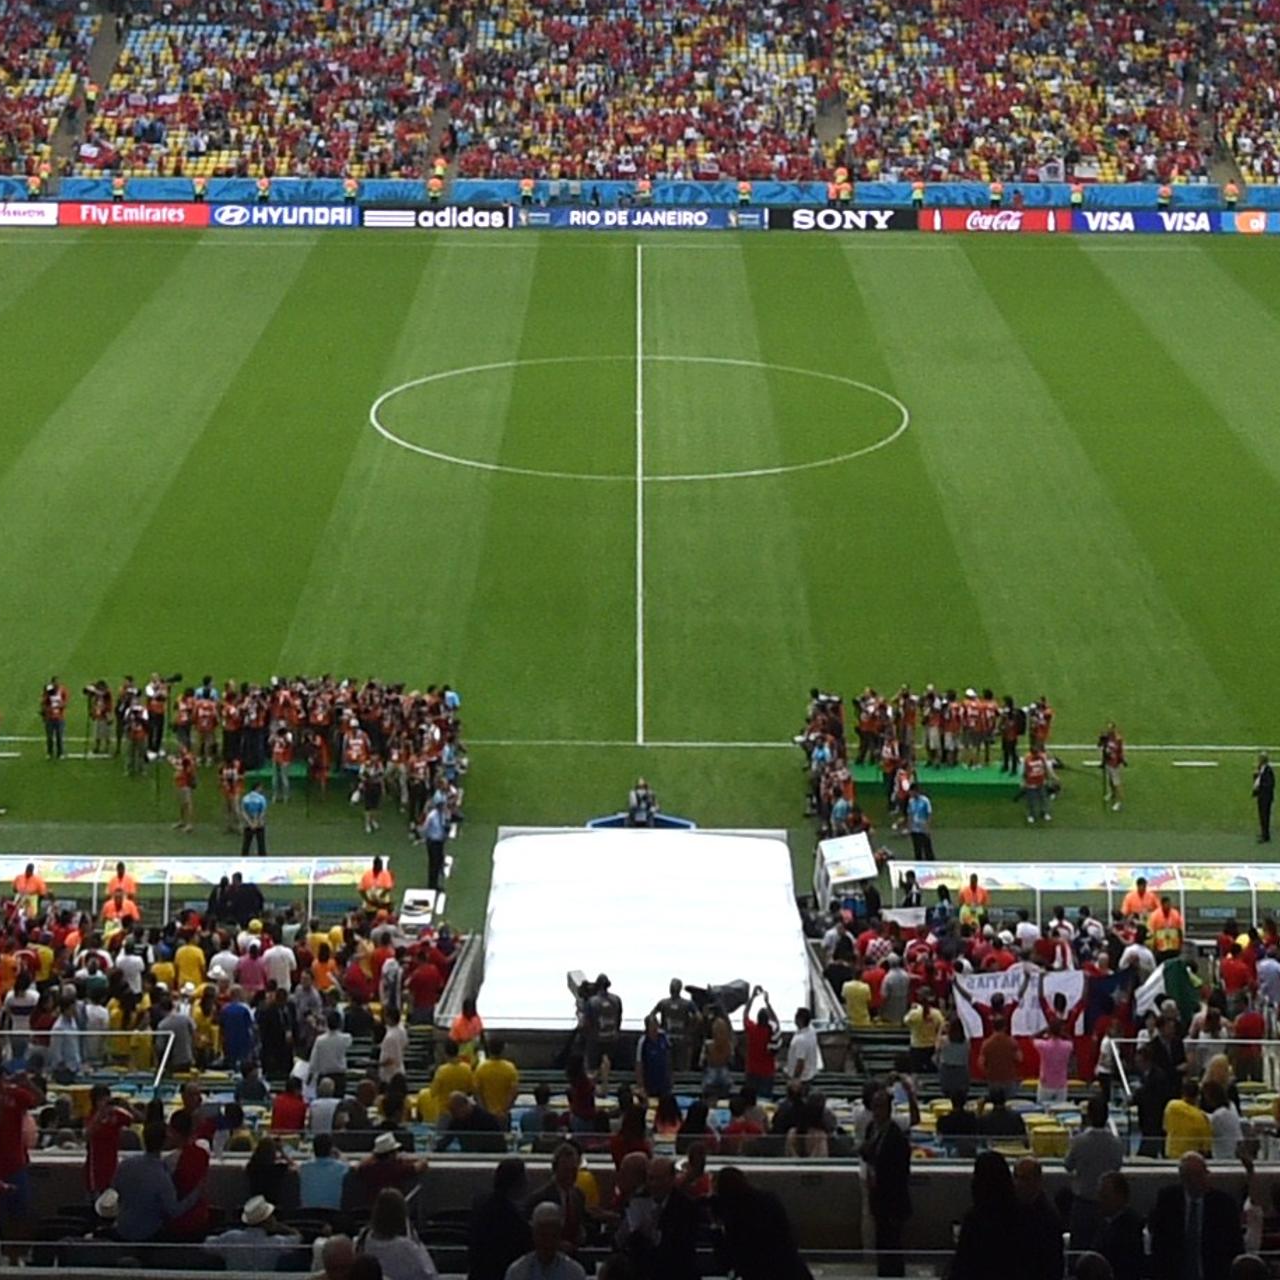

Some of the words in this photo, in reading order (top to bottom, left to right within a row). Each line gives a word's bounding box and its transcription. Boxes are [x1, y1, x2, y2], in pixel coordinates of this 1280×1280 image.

[79, 204, 108, 225] Fly
[111, 204, 185, 223] Emirates
[253, 207, 351, 225] HYUNDAI
[418, 206, 505, 228] adidas
[570, 210, 600, 226] RIO
[604, 210, 628, 226] DE
[632, 210, 708, 227] JANEIRO
[792, 209, 894, 230] SONY
[1082, 211, 1135, 231] VISA
[1158, 211, 1211, 232] VISA
